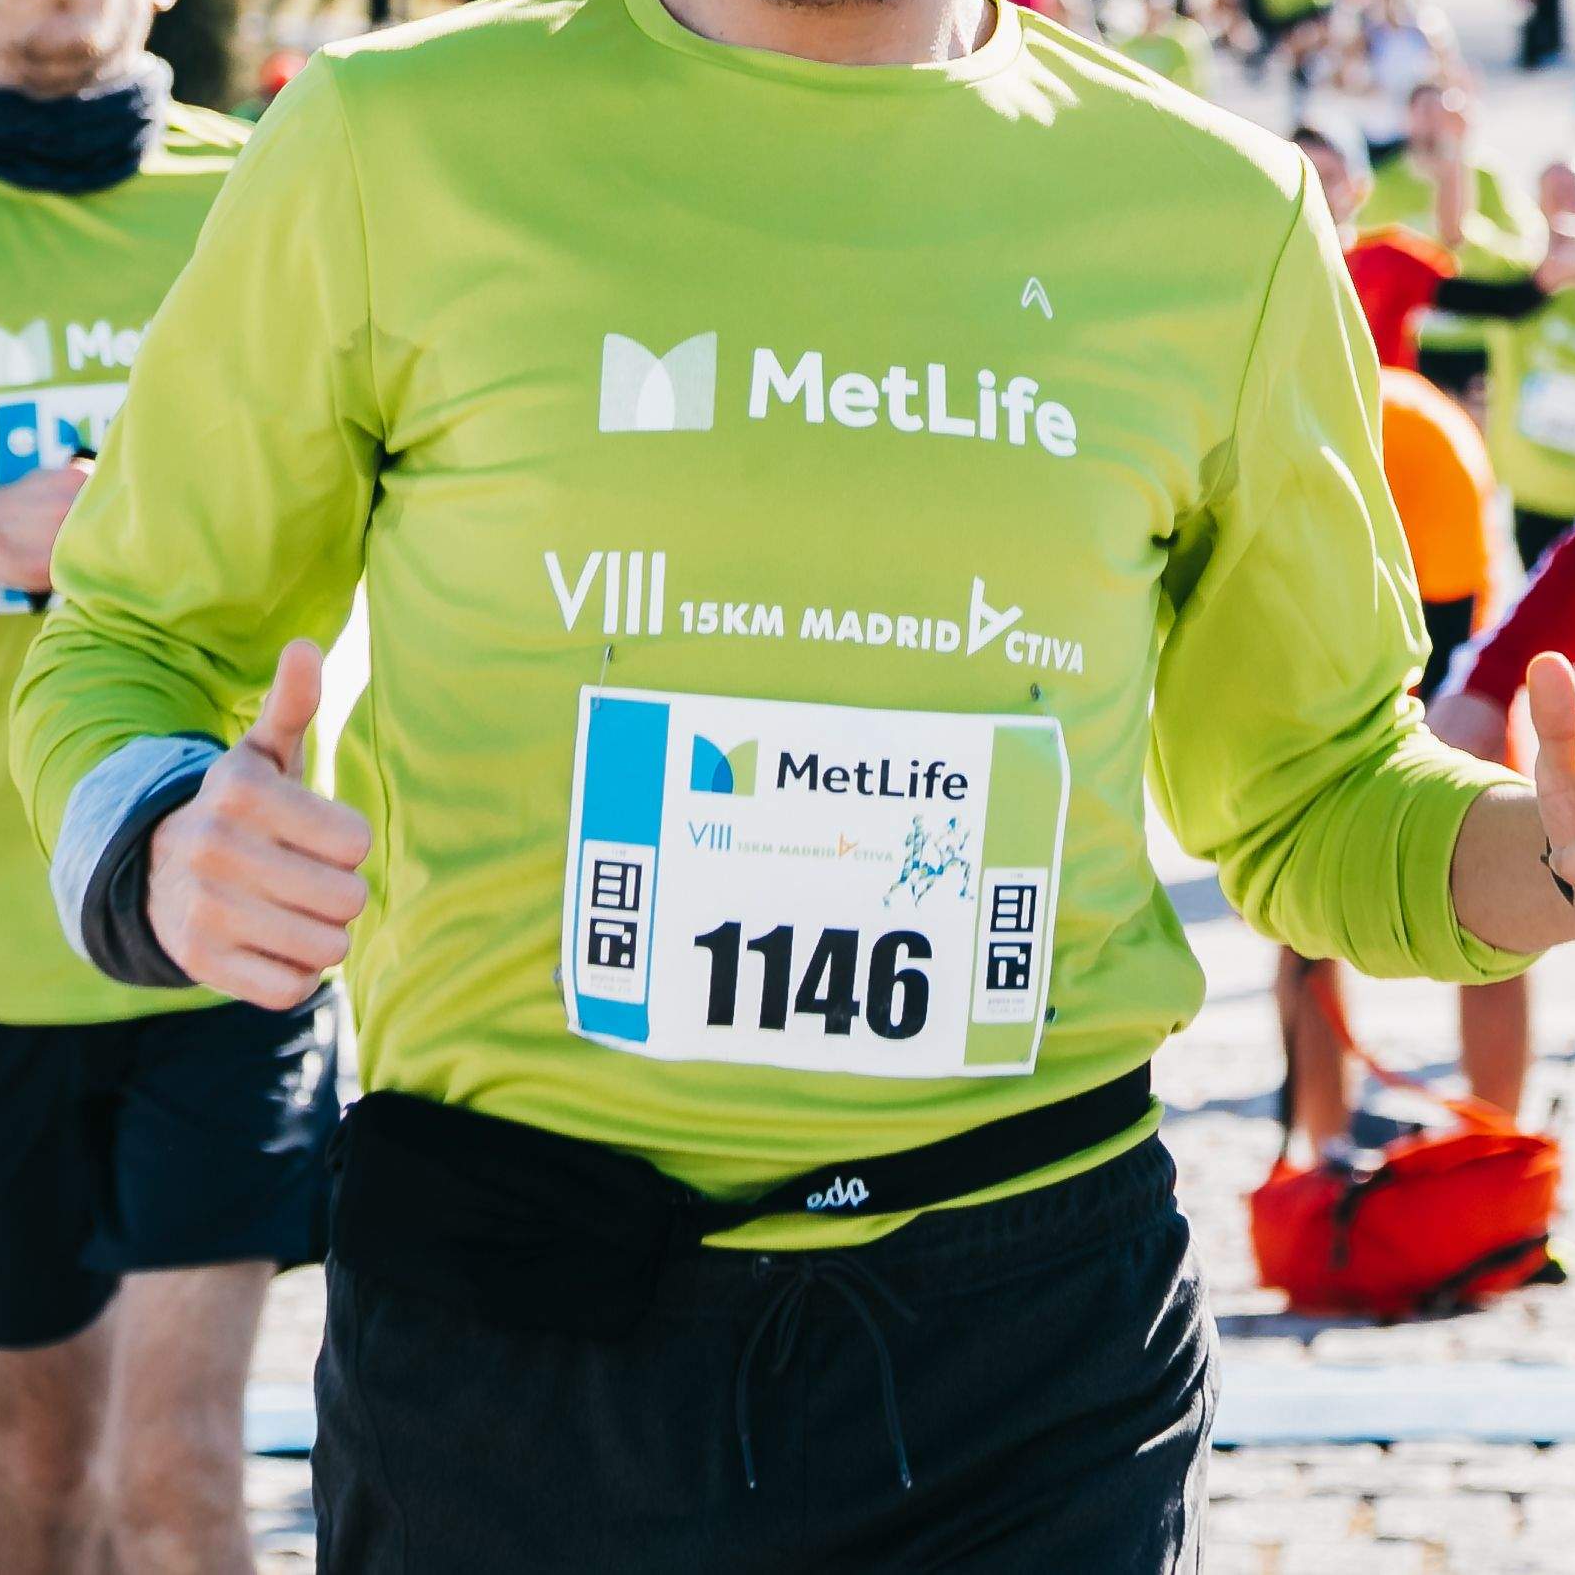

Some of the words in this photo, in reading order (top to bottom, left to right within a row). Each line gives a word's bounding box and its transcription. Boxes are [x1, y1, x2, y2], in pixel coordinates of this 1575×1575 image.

[748, 347, 1077, 457] MetLife
[544, 550, 666, 636] VIII
[679, 600, 786, 638] 15KM
[799, 607, 962, 653] MADRID
[776, 752, 969, 801] MetLife
[686, 820, 733, 851] VIII
[693, 920, 933, 1040] 1146
